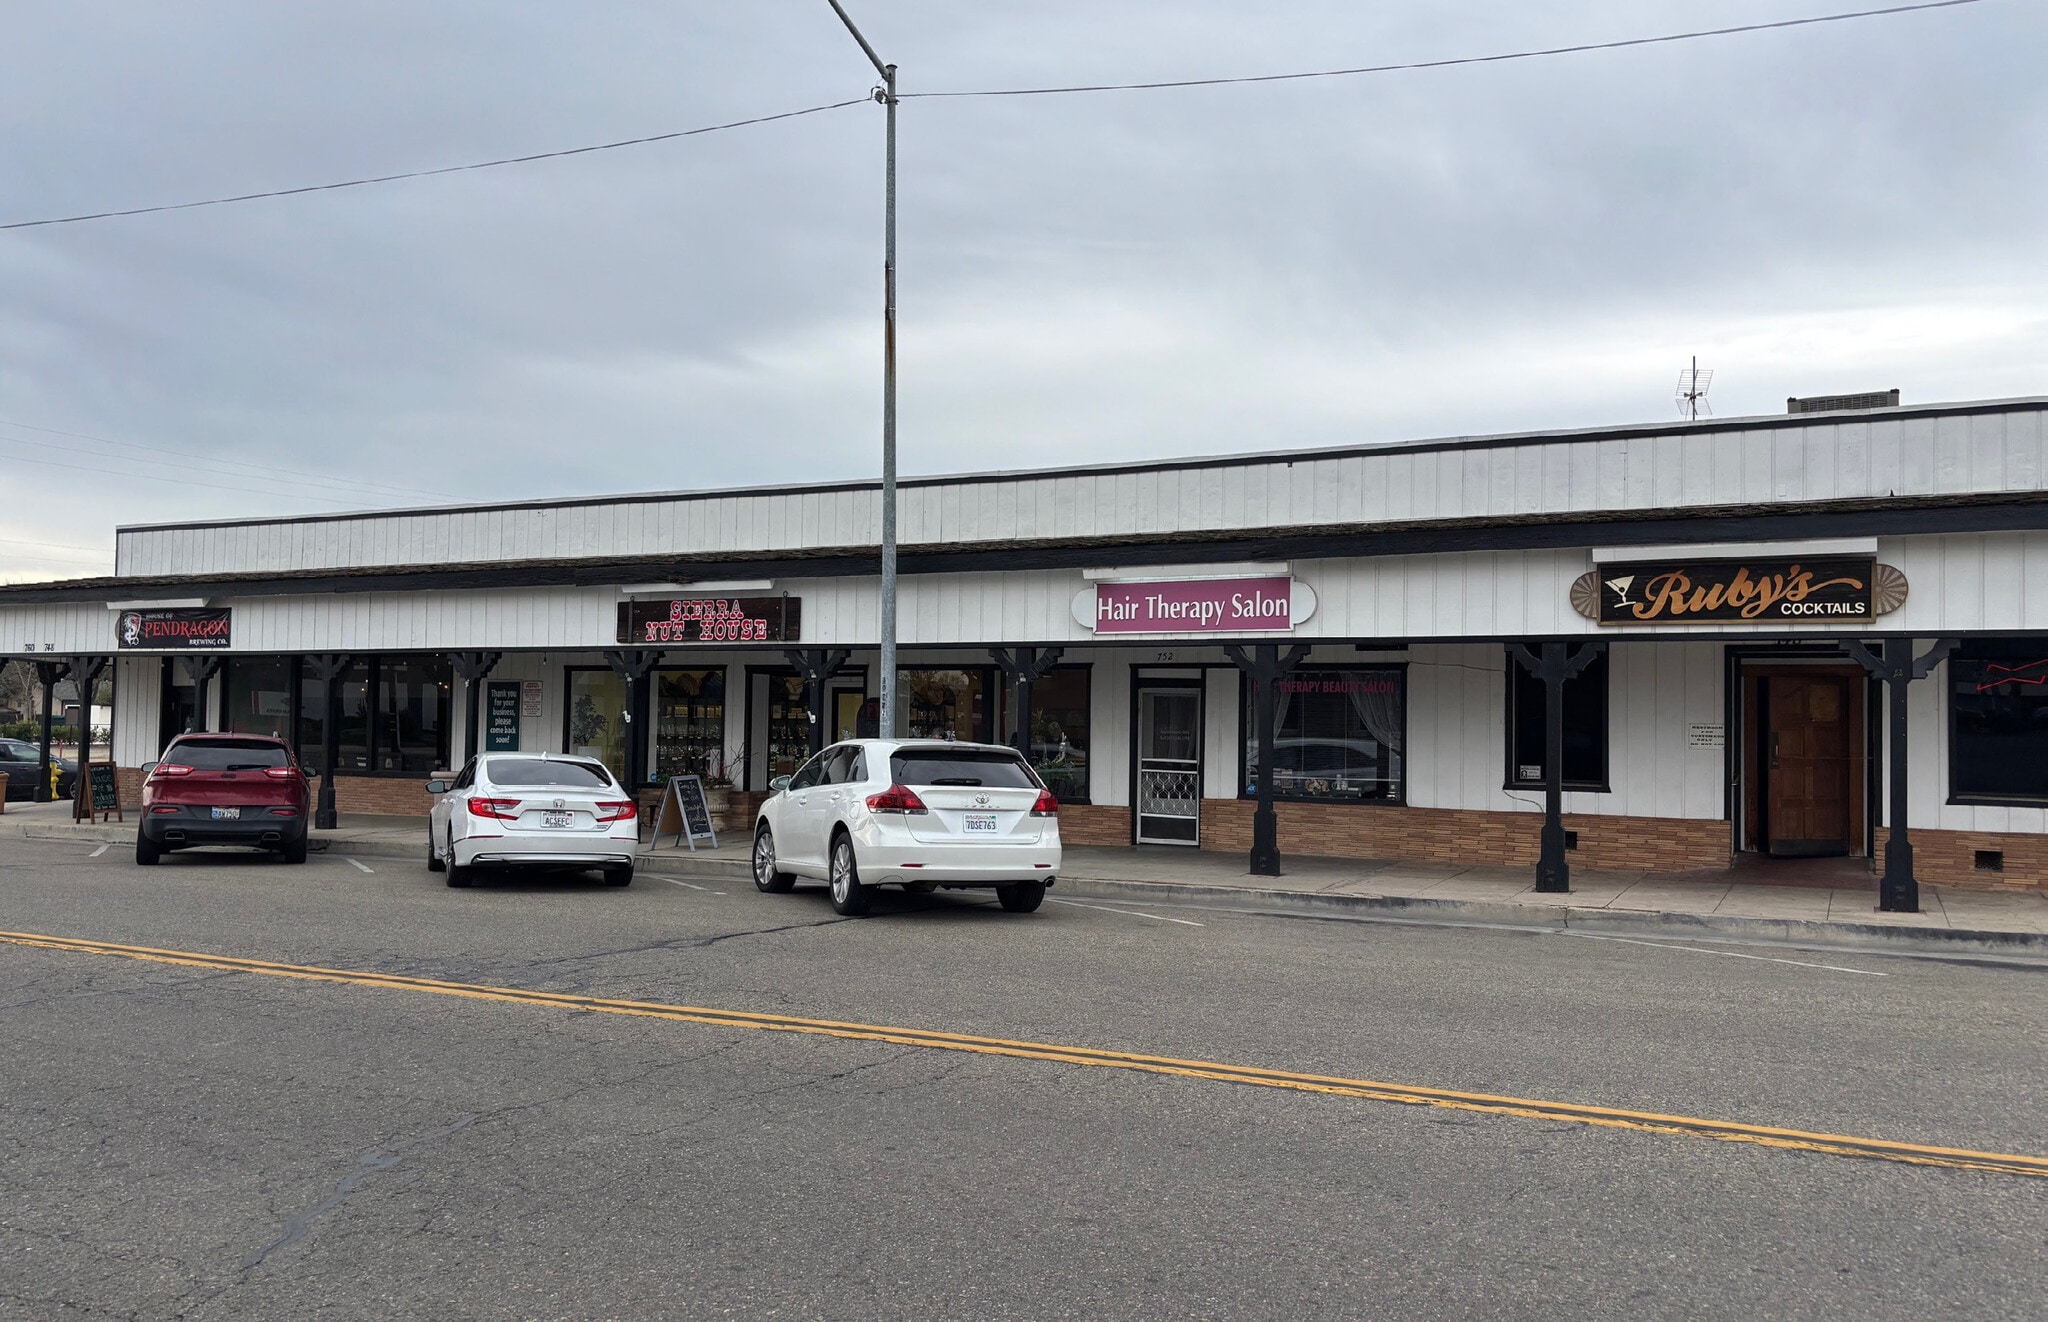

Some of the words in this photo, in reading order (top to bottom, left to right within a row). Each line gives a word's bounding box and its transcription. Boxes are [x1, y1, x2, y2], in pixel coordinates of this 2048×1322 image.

[1632, 565, 1863, 619] Ruby's
[670, 599, 744, 621] SIERRA
[1098, 595, 1139, 621] Hair
[1145, 594, 1226, 626] Therapy
[1231, 590, 1288, 618] Salon
[1781, 602, 1865, 616] COCKTAILS
[145, 620, 229, 639] PENDRAGON
[645, 620, 685, 642] NUT
[700, 618, 768, 641] HOUSE
[188, 638, 217, 646] BREWING
[1157, 652, 1173, 661] 752
[1361, 680, 1395, 694] SALON
[966, 820, 996, 830] 7DSE763
